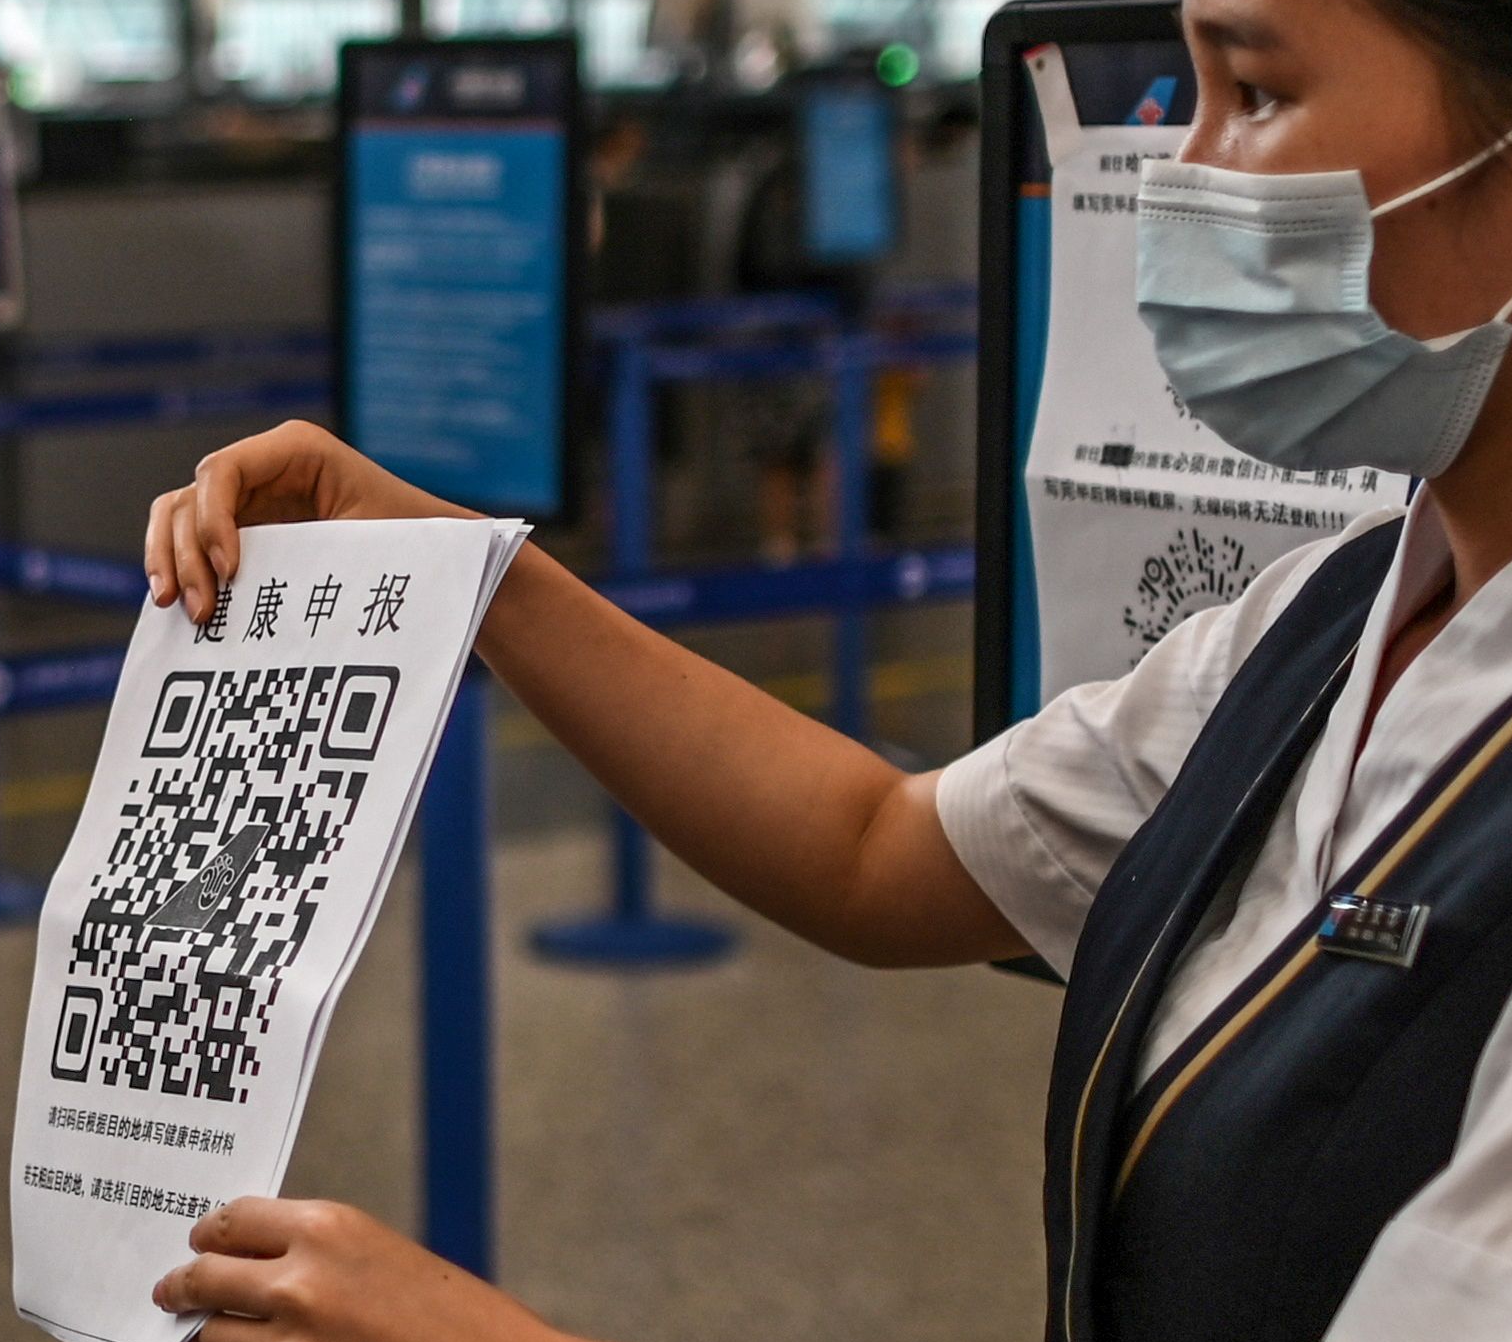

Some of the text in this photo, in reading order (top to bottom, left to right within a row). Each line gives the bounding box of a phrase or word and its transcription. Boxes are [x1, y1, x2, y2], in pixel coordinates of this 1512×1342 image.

[193, 573, 412, 645] 健康申报
[48, 1106, 235, 1156] 请扫码后根据目的地填写健康申报材料
